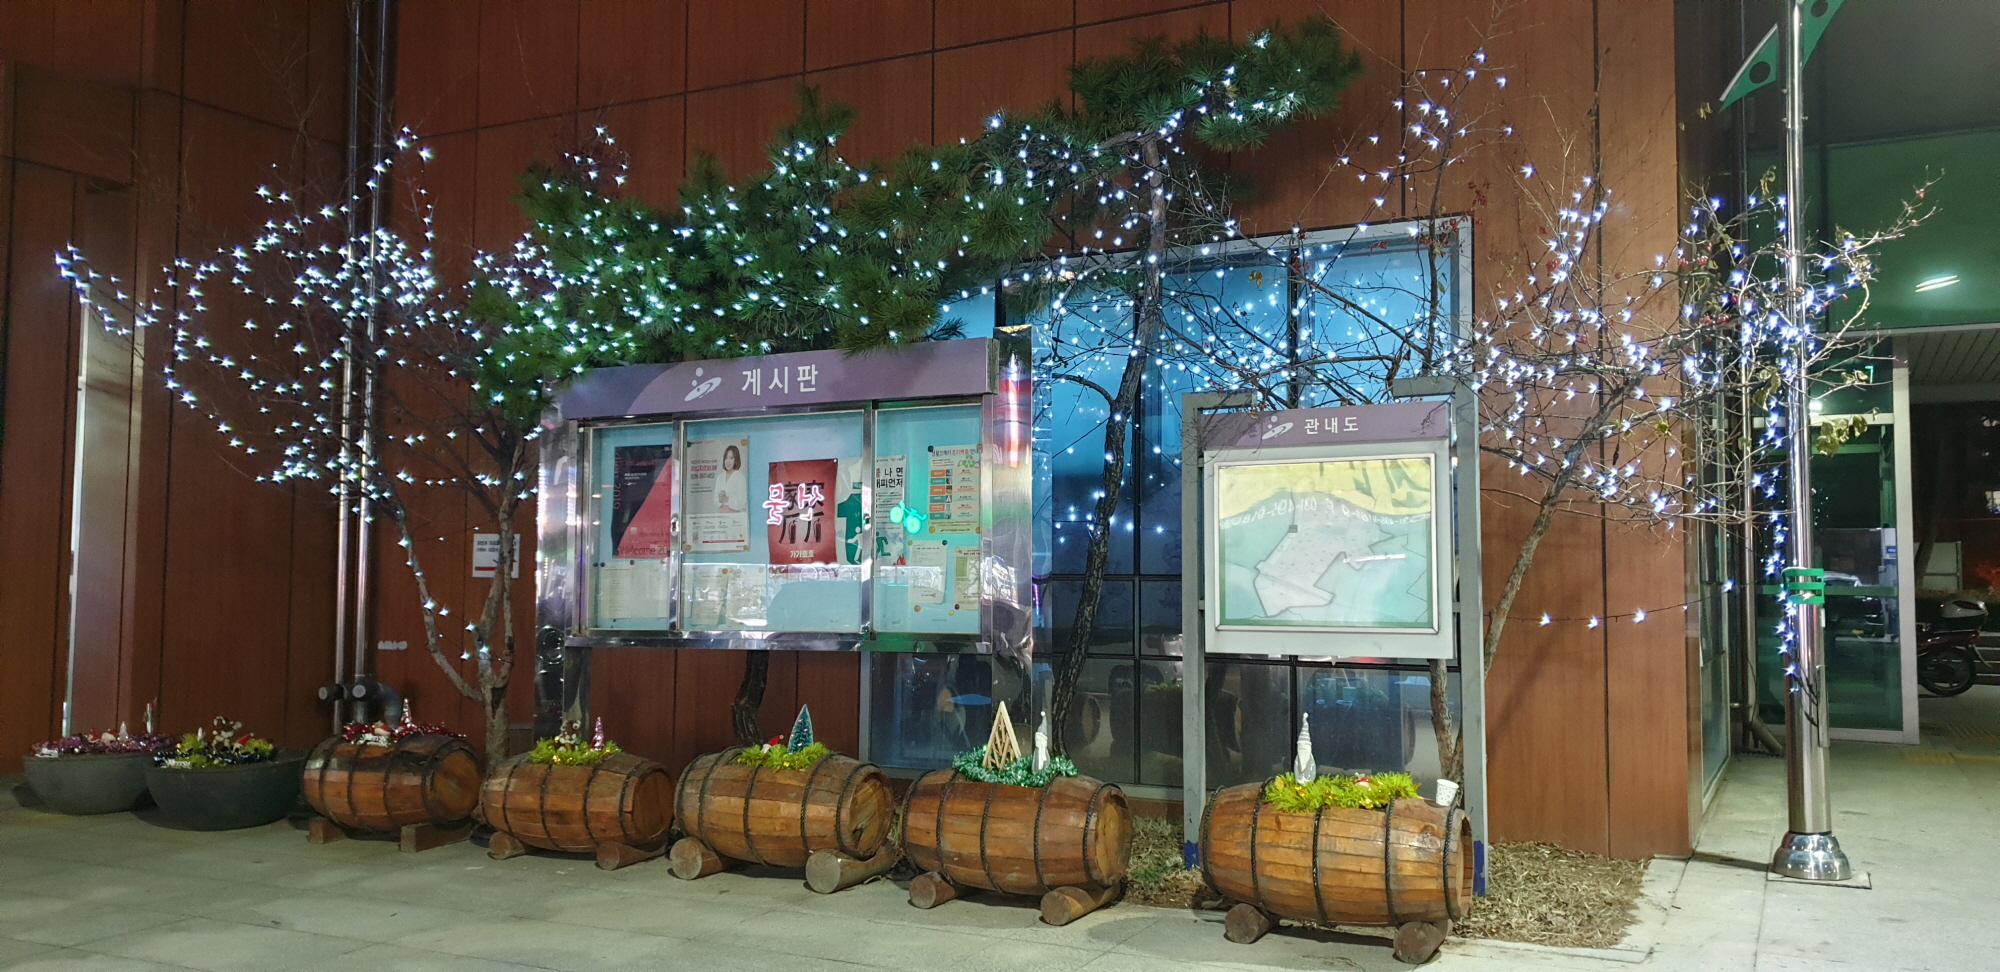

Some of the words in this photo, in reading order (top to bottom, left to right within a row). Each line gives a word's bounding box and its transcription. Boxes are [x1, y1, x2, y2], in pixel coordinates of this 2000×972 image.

[741, 364, 819, 396] 게시판
[1304, 416, 1359, 435] 관내도
[613, 482, 622, 510] 2019
[619, 545, 656, 556] Welcome
